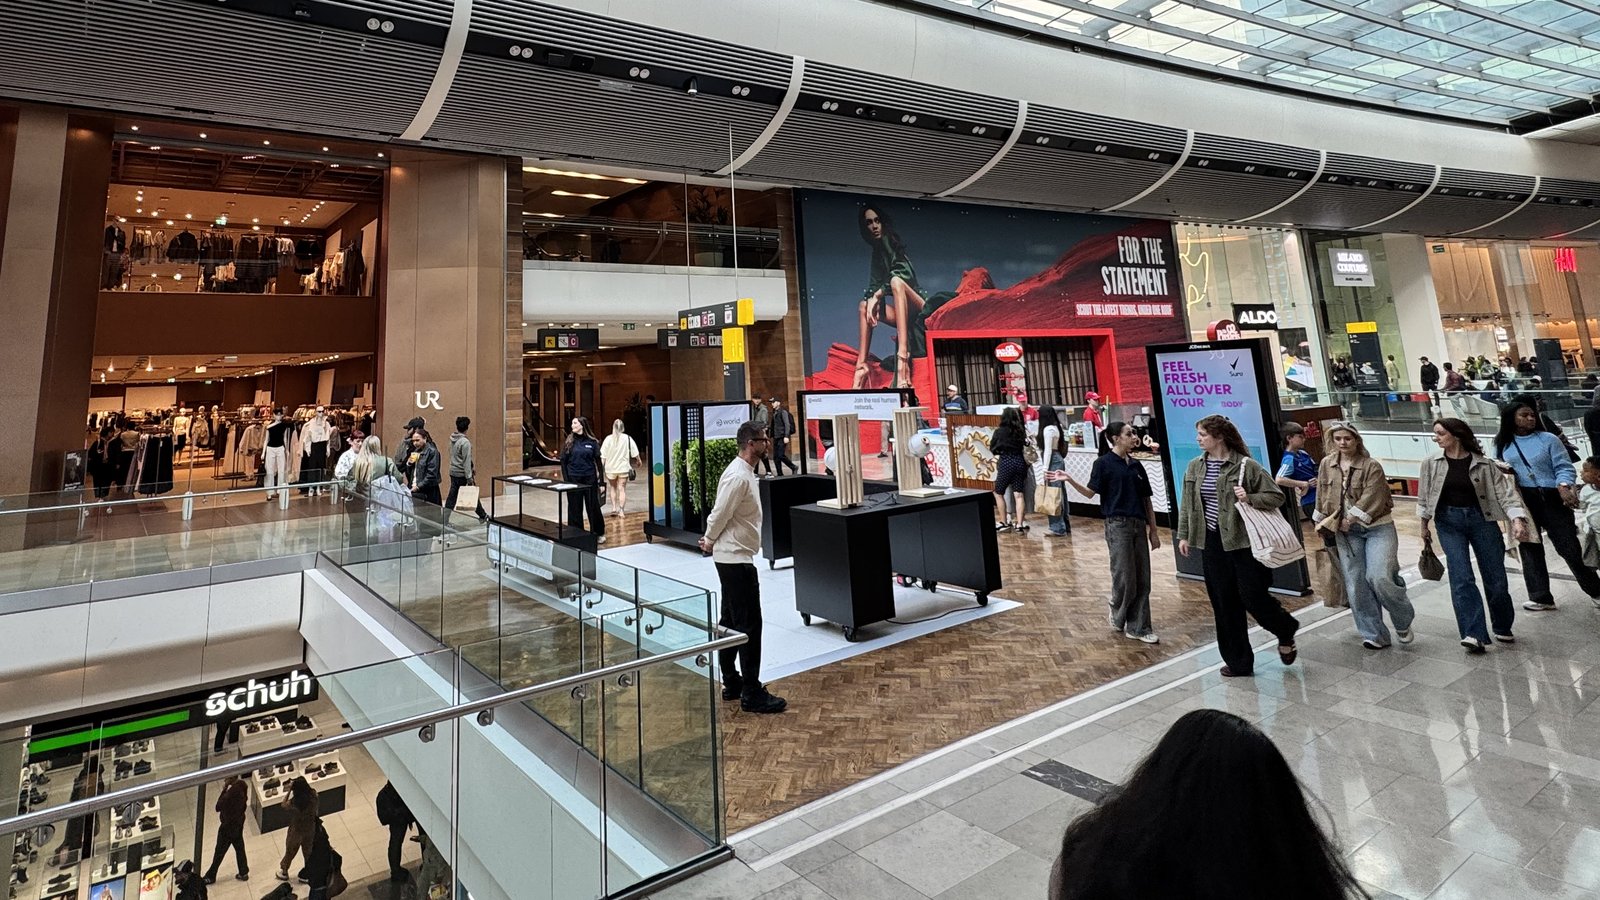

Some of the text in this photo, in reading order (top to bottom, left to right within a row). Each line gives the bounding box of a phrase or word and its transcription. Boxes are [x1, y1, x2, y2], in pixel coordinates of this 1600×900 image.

[1117, 235, 1166, 265] FOR THE
[1101, 265, 1168, 296] STATEMENT
[1239, 310, 1278, 324] ALDO
[1162, 360, 1193, 372] FEEL
[1164, 372, 1208, 384] FRESH
[1166, 384, 1233, 396] ALL OVER
[415, 390, 444, 410] UR
[1170, 398, 1206, 408] YOUR
[723, 417, 741, 425] world
[205, 669, 311, 717] schuh
